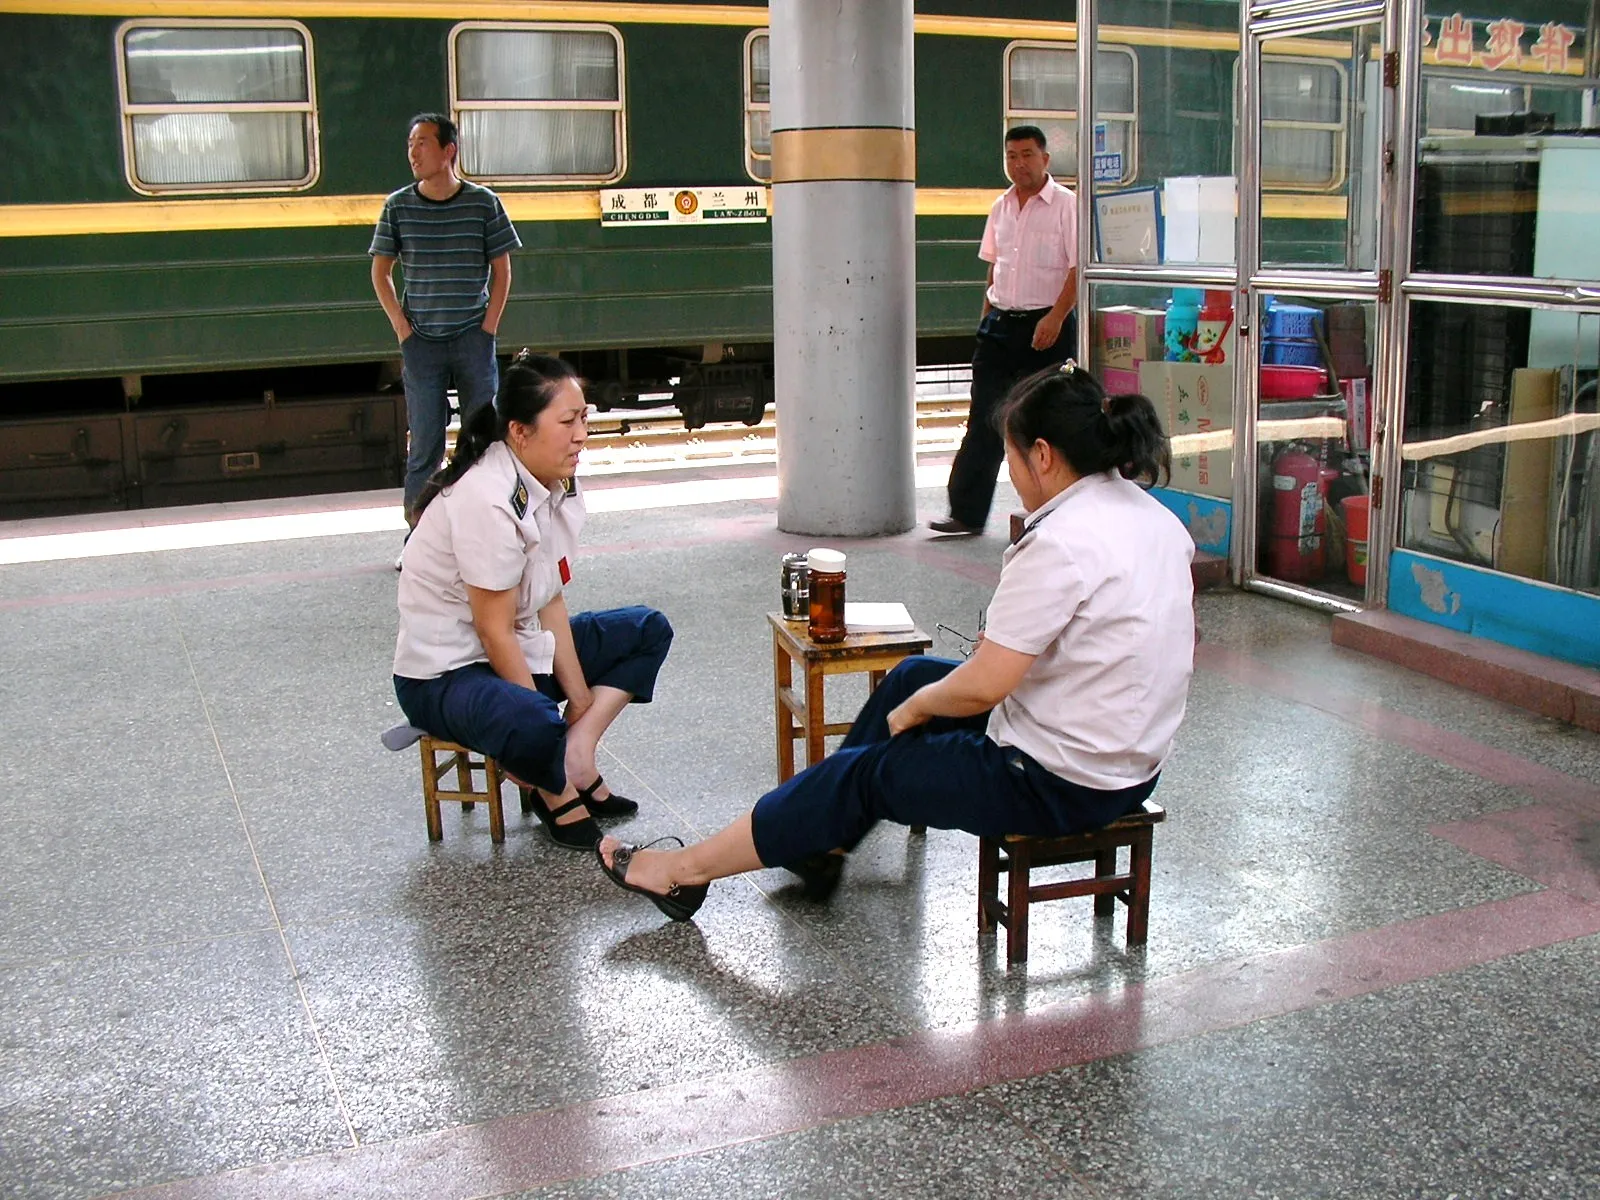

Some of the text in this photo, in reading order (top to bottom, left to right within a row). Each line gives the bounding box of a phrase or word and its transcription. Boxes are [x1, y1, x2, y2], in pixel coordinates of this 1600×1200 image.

[612, 191, 759, 210] 成都 兰州
[610, 213, 660, 221] CHENGDU
